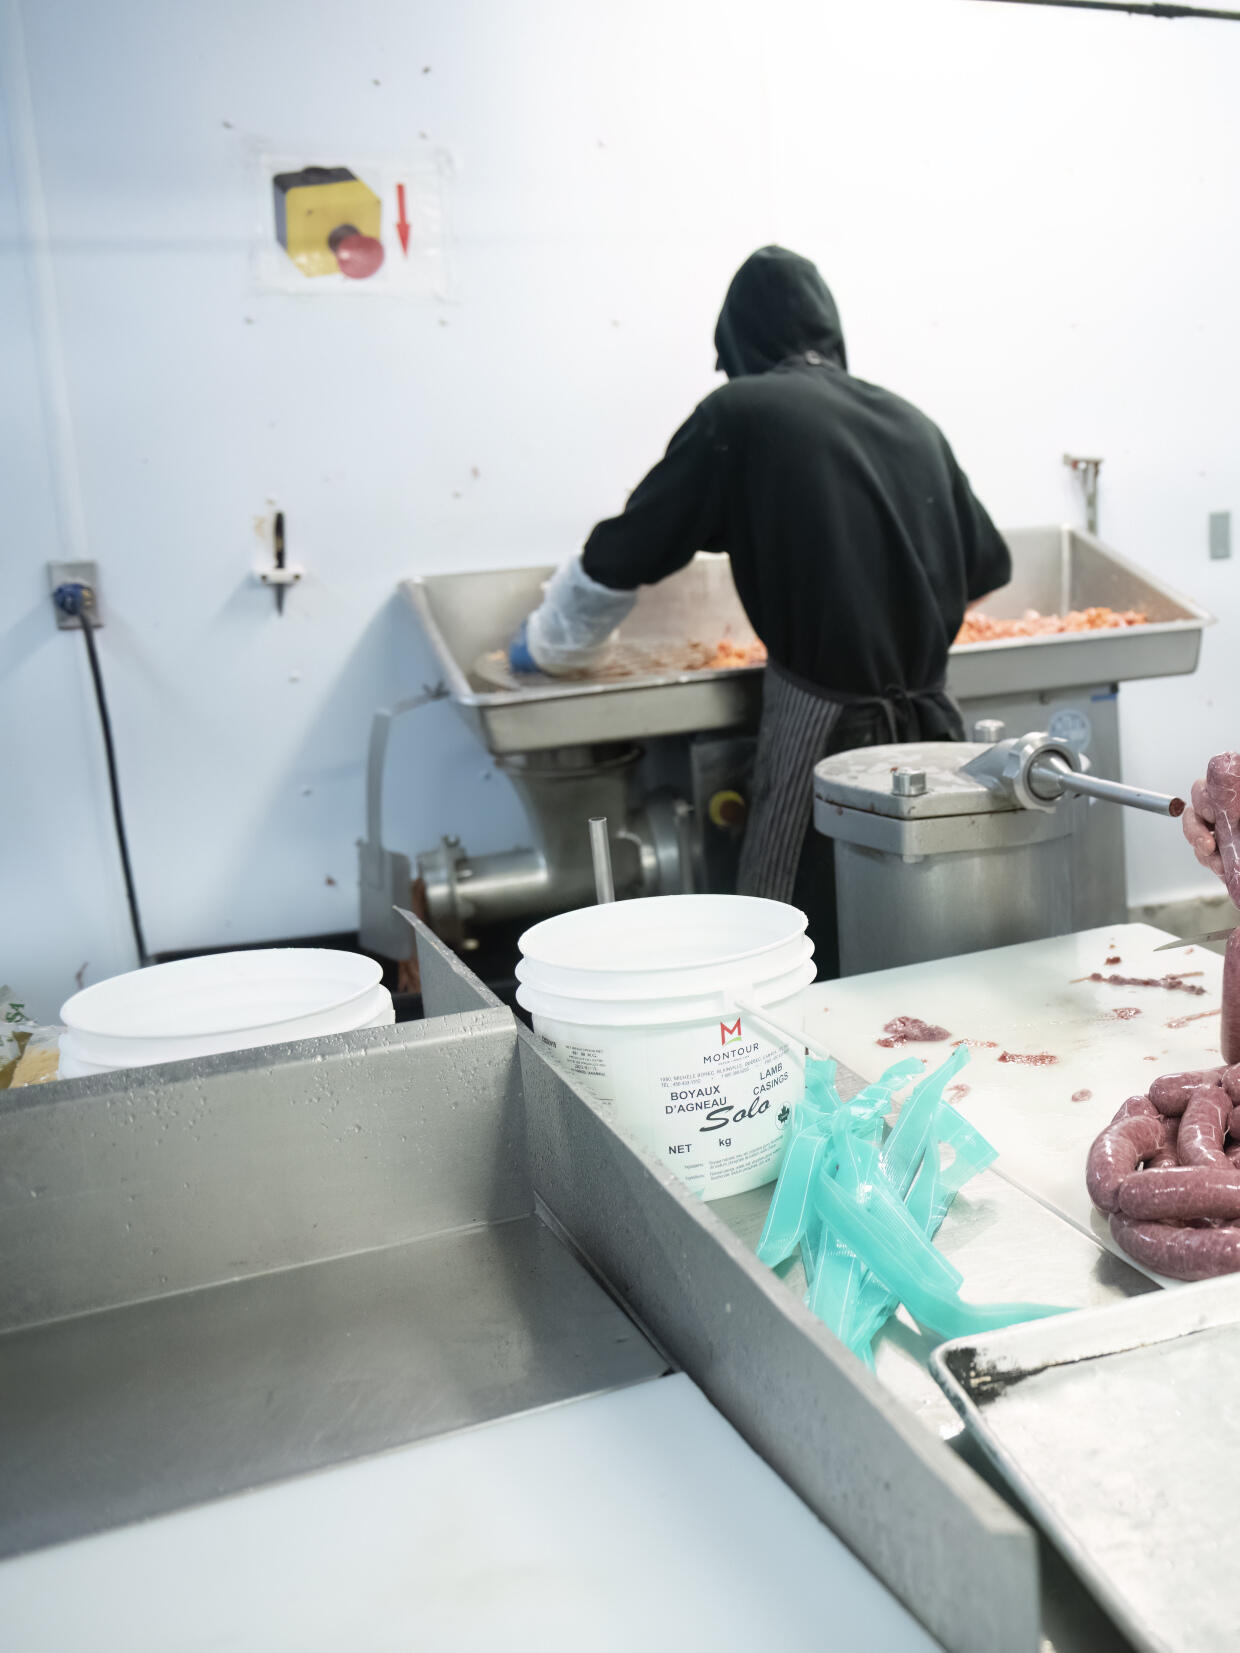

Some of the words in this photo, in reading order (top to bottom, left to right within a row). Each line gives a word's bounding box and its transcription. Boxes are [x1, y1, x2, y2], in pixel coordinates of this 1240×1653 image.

[703, 1043, 759, 1064] MONTOUR
[759, 1063, 783, 1080] LAMB
[670, 1085, 720, 1101] BOYAUX
[753, 1072, 789, 1096] CASINGS
[665, 1097, 727, 1115] D'AGNEAU
[699, 1096, 770, 1132] Solo
[668, 1144, 692, 1155] NET
[719, 1138, 732, 1147] kg
